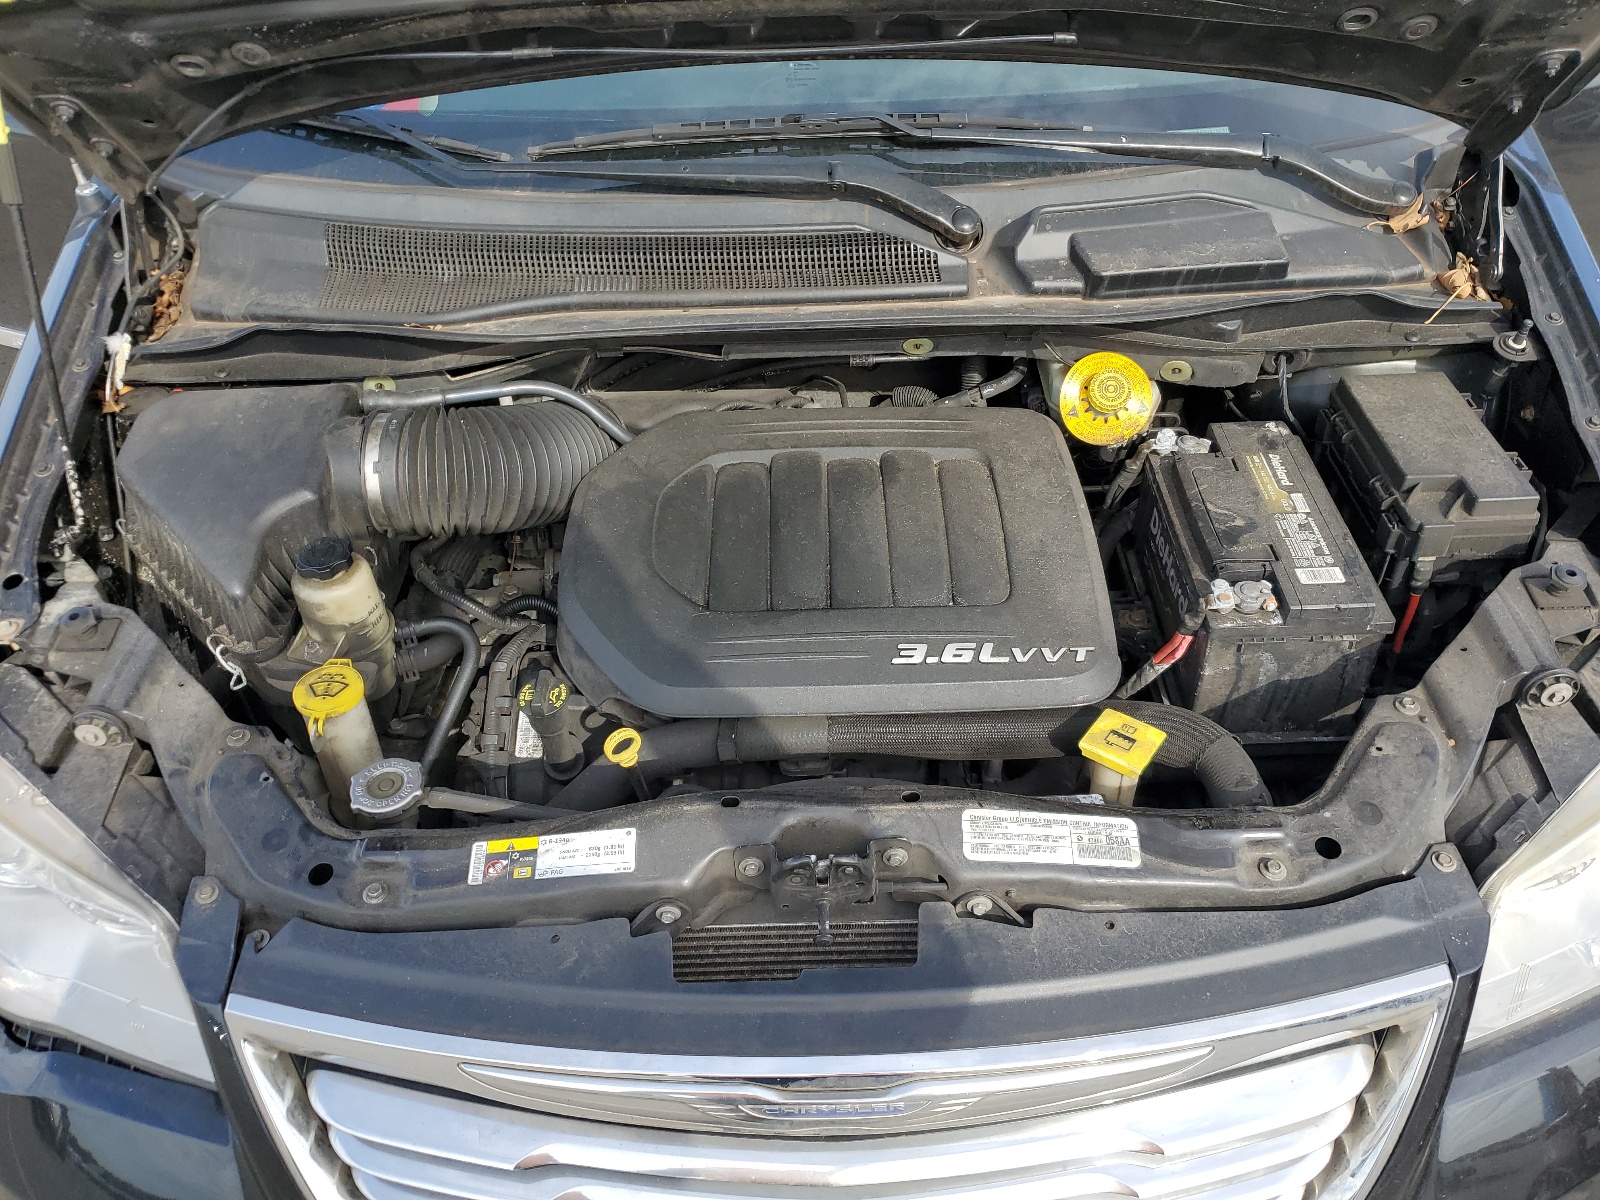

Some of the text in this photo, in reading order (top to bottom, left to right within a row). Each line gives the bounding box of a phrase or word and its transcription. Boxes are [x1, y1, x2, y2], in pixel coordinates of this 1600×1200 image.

[1268, 453, 1294, 486] DieHard
[1281, 498, 1292, 511] GOLD
[1150, 507, 1189, 620] DieHard
[891, 642, 1096, 664] 3.6L VVT
[376, 796, 401, 807] OPEN
[1069, 819, 1092, 827] CONTROL
[1093, 821, 1129, 830] INFORMATION
[550, 868, 564, 876] PAG
[762, 1101, 905, 1115] CHRYSLER
